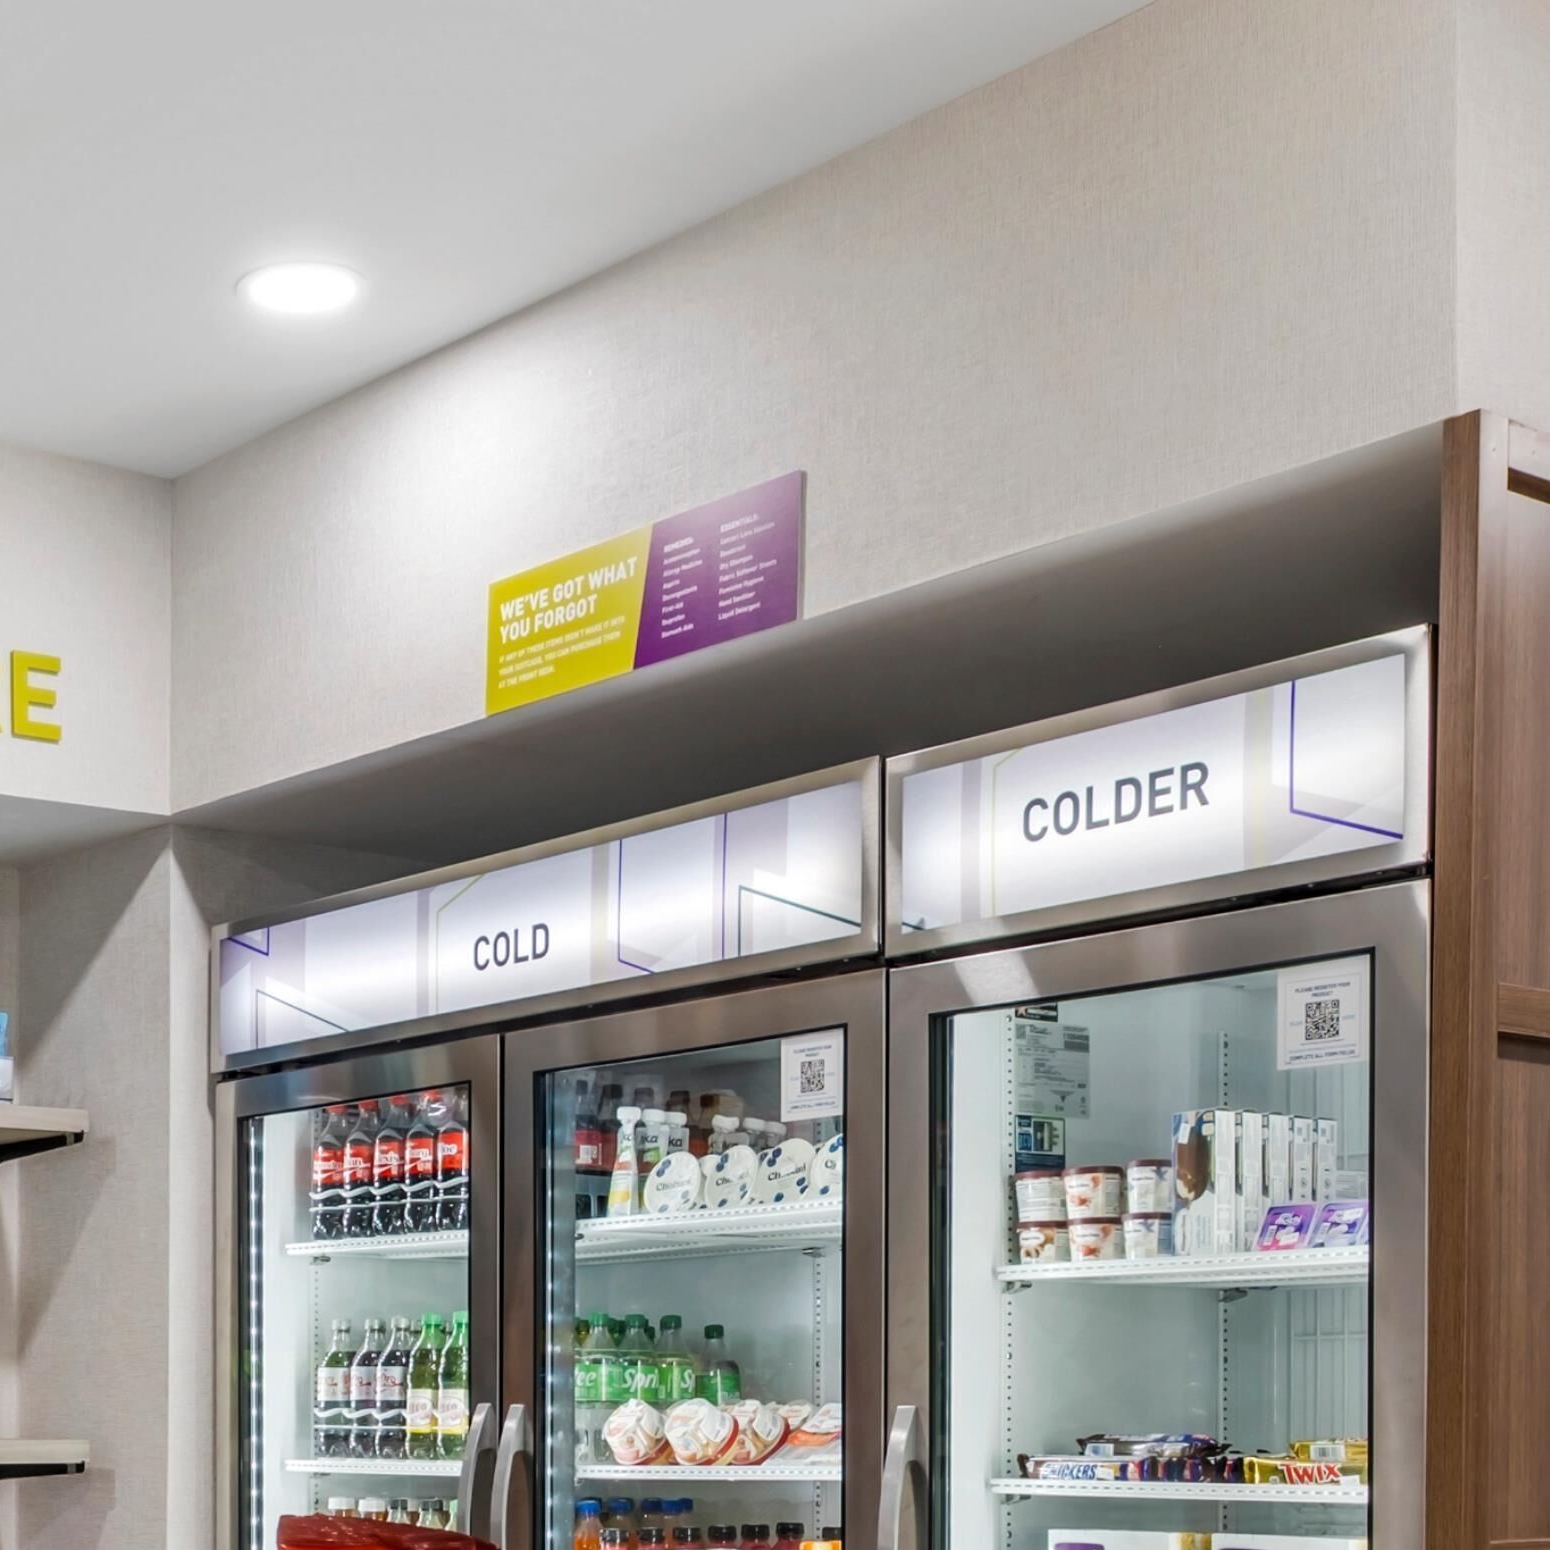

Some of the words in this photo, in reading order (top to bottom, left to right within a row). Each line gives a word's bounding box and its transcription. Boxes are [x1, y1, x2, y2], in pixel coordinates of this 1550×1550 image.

[500, 588, 549, 621] WE'VE
[553, 575, 584, 603] GOT
[588, 556, 638, 590] WHAT
[500, 617, 530, 644] YOU
[534, 593, 597, 633] FORGOT
[1022, 762, 1210, 842] COLDER
[473, 922, 551, 972] COLD
[623, 1367, 659, 1392] Spri
[1053, 1463, 1098, 1480] ICKERS
[1280, 1462, 1342, 1485] TWIX
